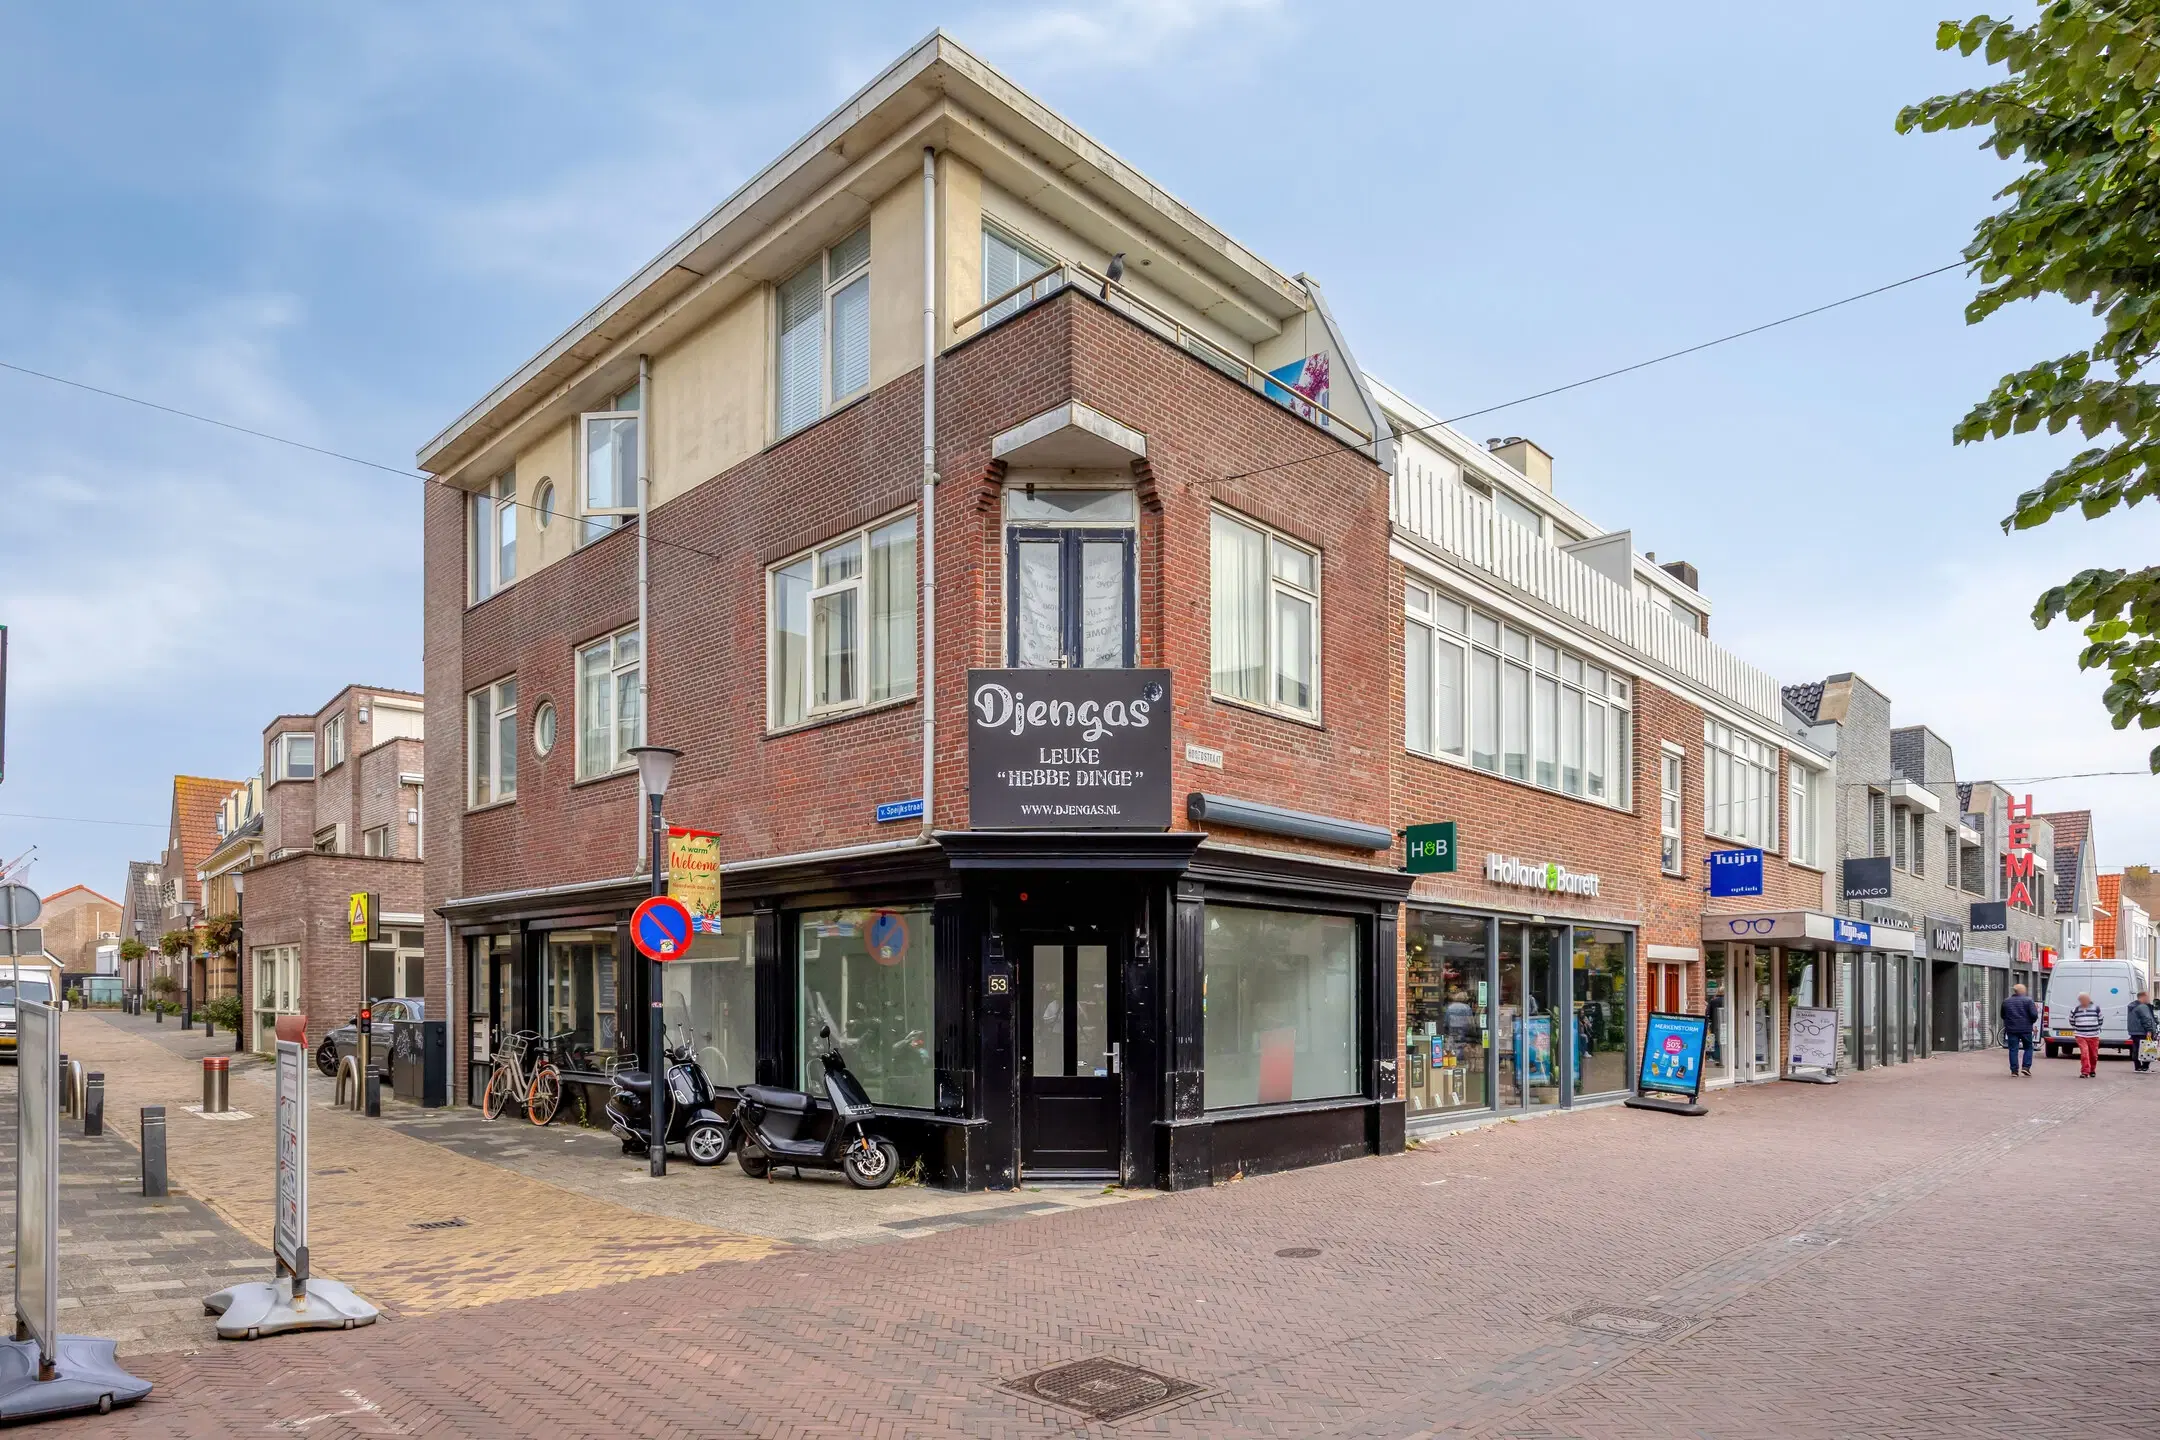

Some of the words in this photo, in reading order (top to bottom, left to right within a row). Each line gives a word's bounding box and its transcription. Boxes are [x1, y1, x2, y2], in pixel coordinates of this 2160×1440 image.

[974, 683, 1150, 742] Djengas
[1039, 747, 1100, 765] LEUKE
[1021, 804, 1121, 816] WWW.DJENGAS.NL
[687, 846, 708, 854] warm
[1411, 839, 1448, 858] H&B
[2006, 794, 2034, 907] HEMA
[671, 851, 719, 872] Welcome
[1713, 852, 1758, 867] Tuijn
[1846, 887, 1888, 897] MANGO
[1972, 923, 2005, 931] MANGO
[1935, 928, 1961, 952] MANGO
[990, 978, 1007, 991] 53
[1654, 1023, 1699, 1033] MERKENSTORM
[1666, 1041, 1681, 1049] 50%
